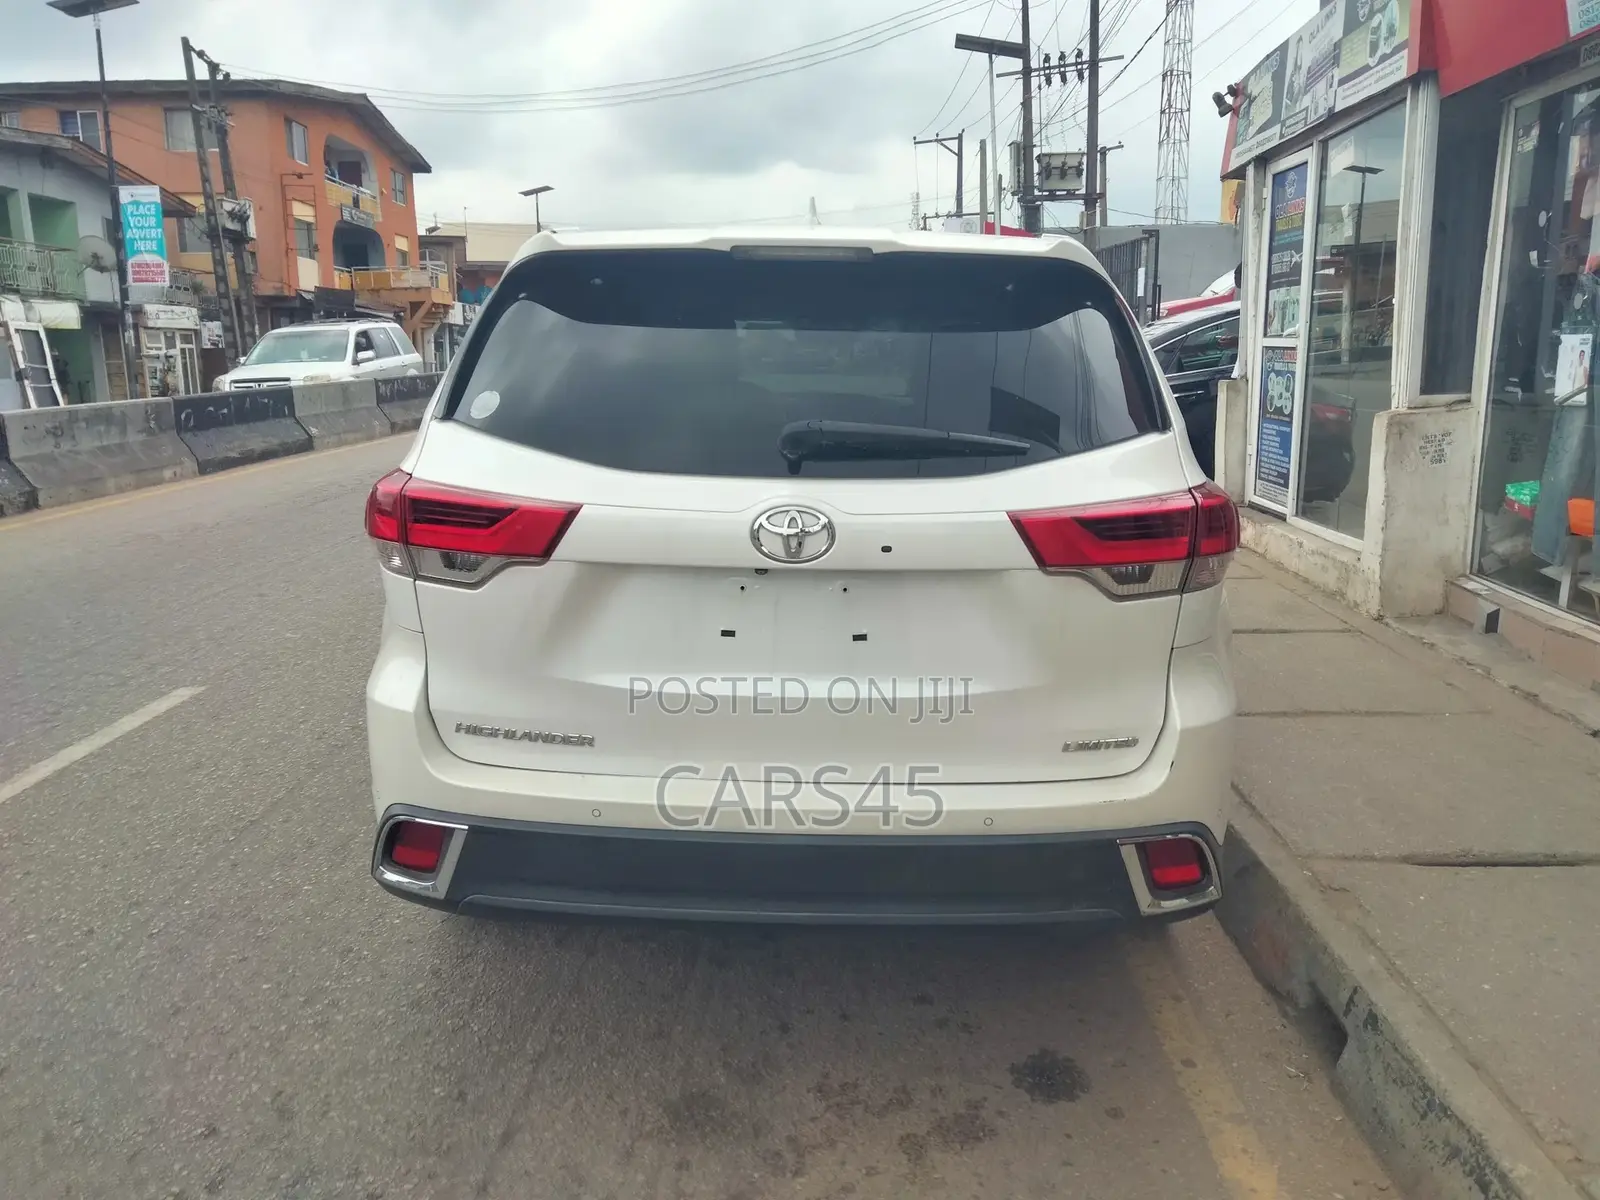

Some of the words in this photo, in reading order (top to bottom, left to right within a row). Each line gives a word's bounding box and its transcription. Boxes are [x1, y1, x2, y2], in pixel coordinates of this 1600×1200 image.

[127, 204, 156, 215] PLACE
[128, 216, 156, 227] YOUR
[126, 229, 162, 239] ADVERT
[133, 240, 157, 251] HERE
[454, 720, 596, 748] HIGHLANDER
[1061, 736, 1140, 753] LIMITED
